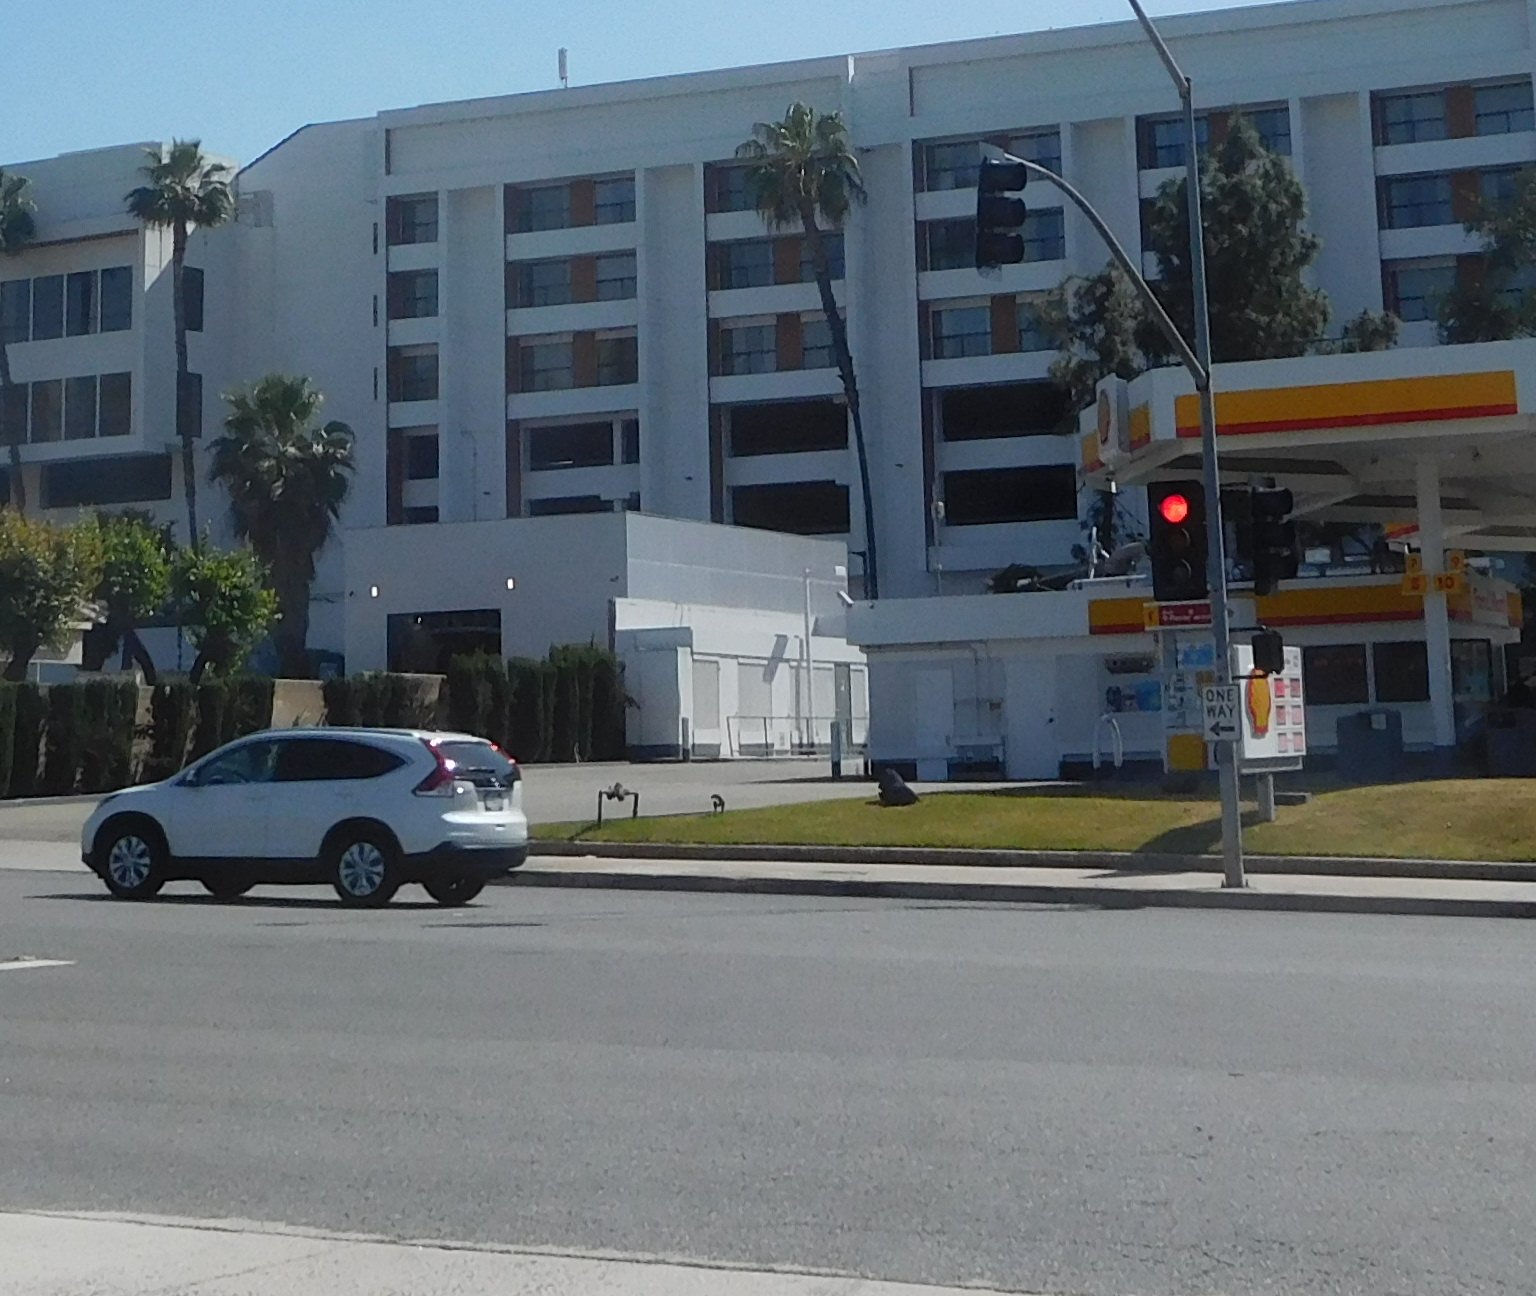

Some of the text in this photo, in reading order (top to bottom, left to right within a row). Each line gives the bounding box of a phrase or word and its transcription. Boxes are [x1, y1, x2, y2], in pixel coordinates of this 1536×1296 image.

[1437, 575, 1455, 590] 10
[1205, 688, 1234, 703] ONE
[1206, 705, 1236, 720] WAY
